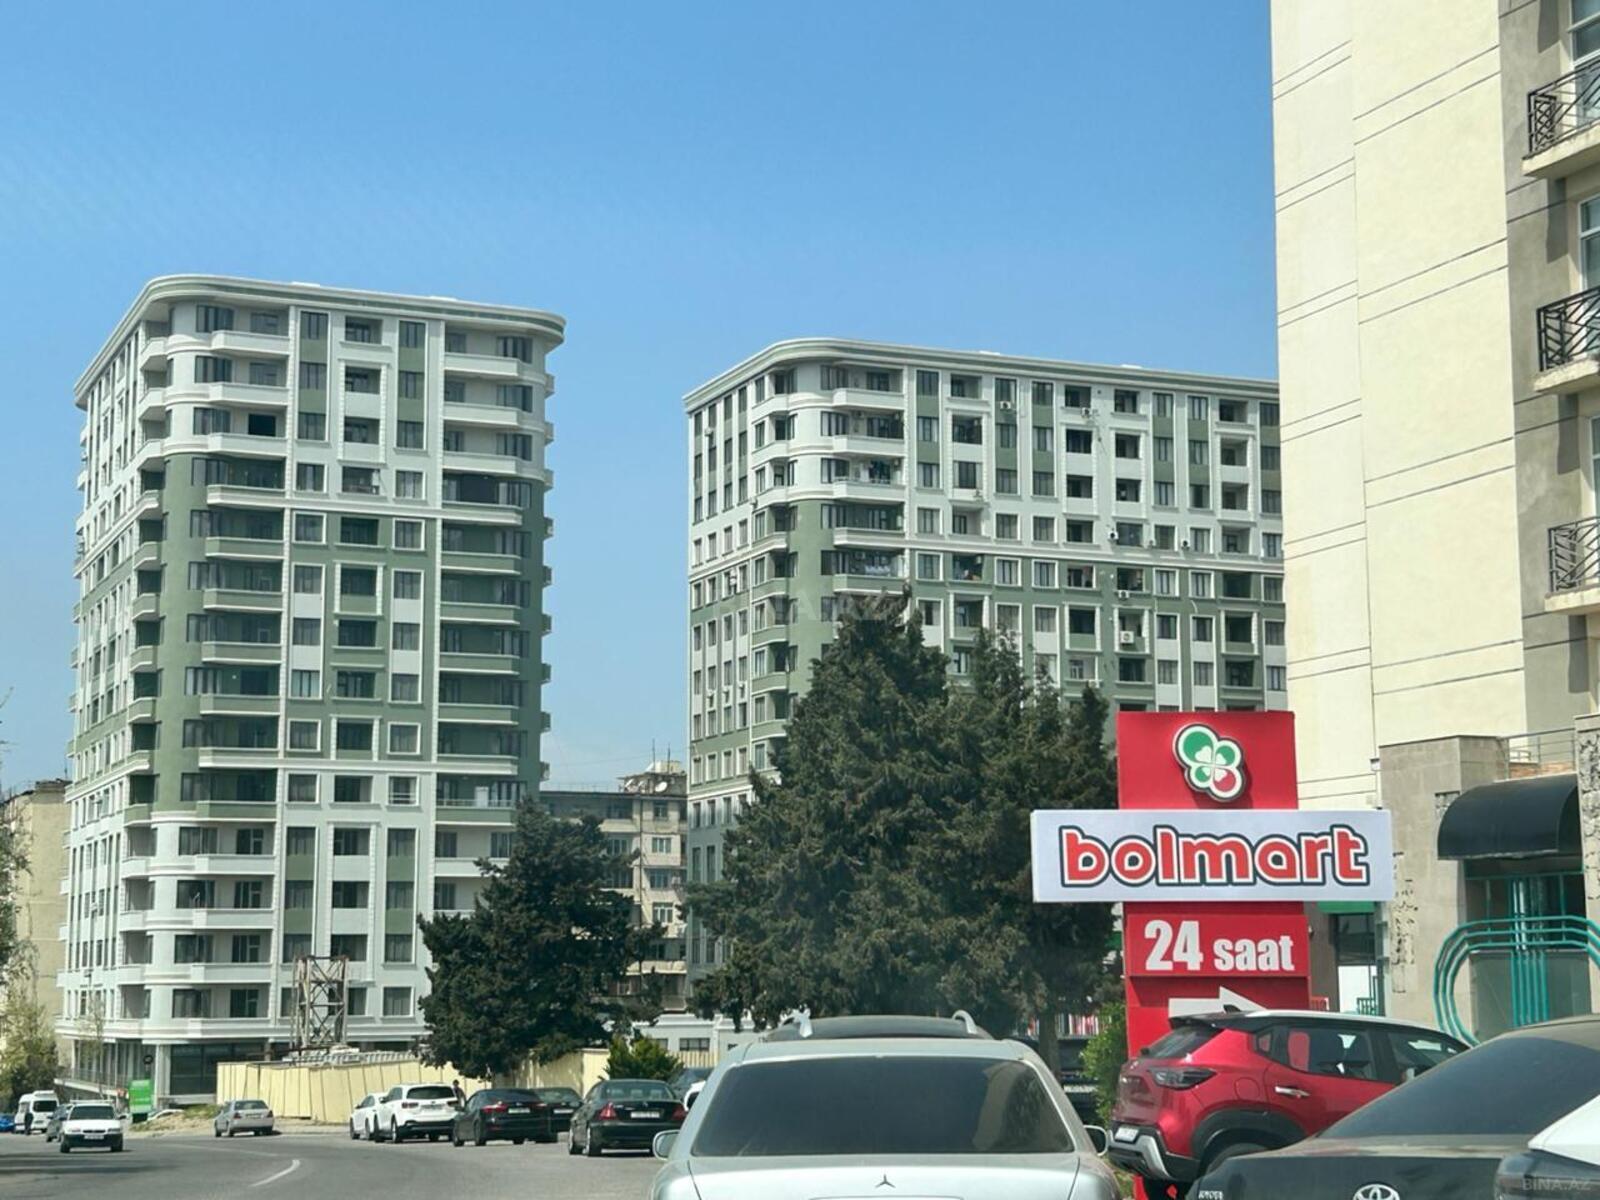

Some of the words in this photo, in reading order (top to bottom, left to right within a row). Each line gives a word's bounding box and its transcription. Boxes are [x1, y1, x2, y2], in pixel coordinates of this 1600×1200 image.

[1059, 824, 1370, 887] bolmart
[1144, 919, 1204, 971] 24
[1213, 935, 1295, 972] saat
